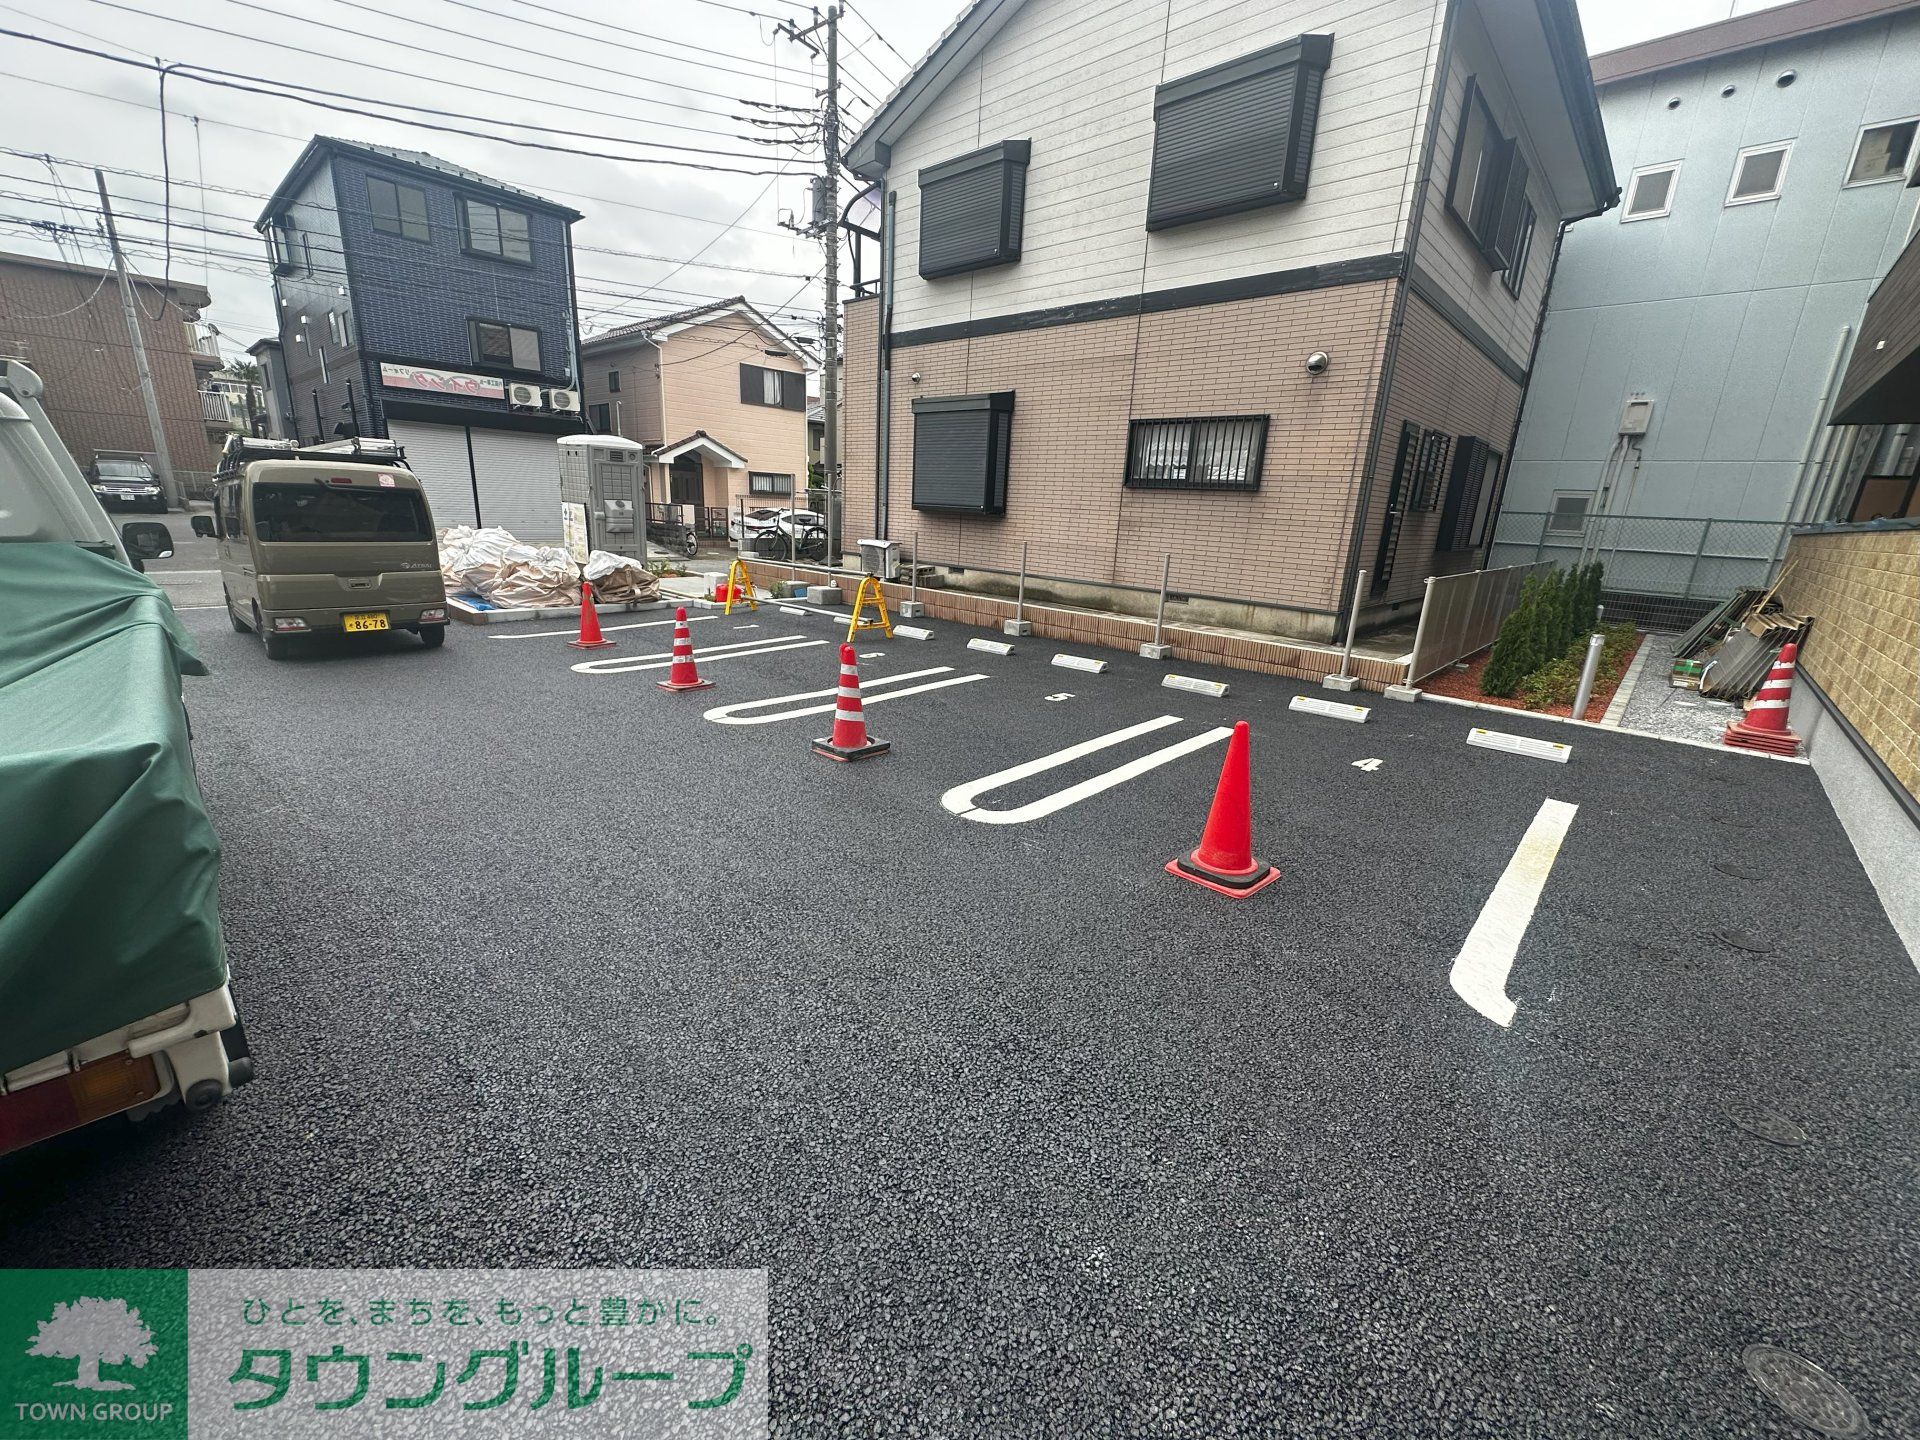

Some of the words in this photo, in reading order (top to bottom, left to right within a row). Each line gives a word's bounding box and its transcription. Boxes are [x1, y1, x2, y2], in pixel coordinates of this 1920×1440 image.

[355, 619, 386, 630] 86-78
[1045, 692, 1076, 702] 5
[1351, 757, 1384, 772] 4
